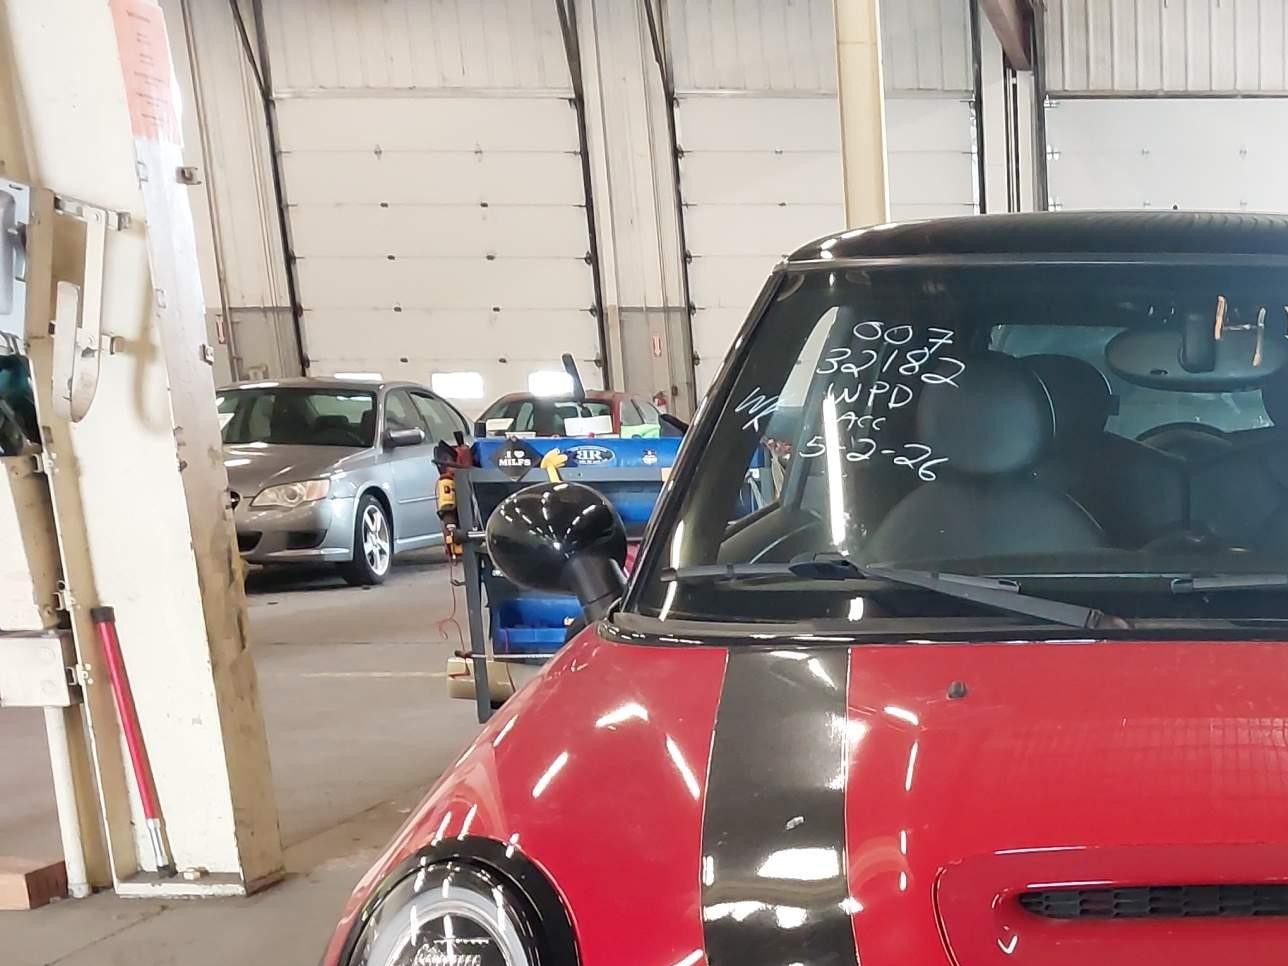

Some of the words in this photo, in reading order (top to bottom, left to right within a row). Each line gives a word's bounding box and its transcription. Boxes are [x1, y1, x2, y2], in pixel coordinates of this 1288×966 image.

[853, 321, 955, 354] 007
[816, 345, 966, 388] 32182
[498, 458, 531, 467] MILFS
